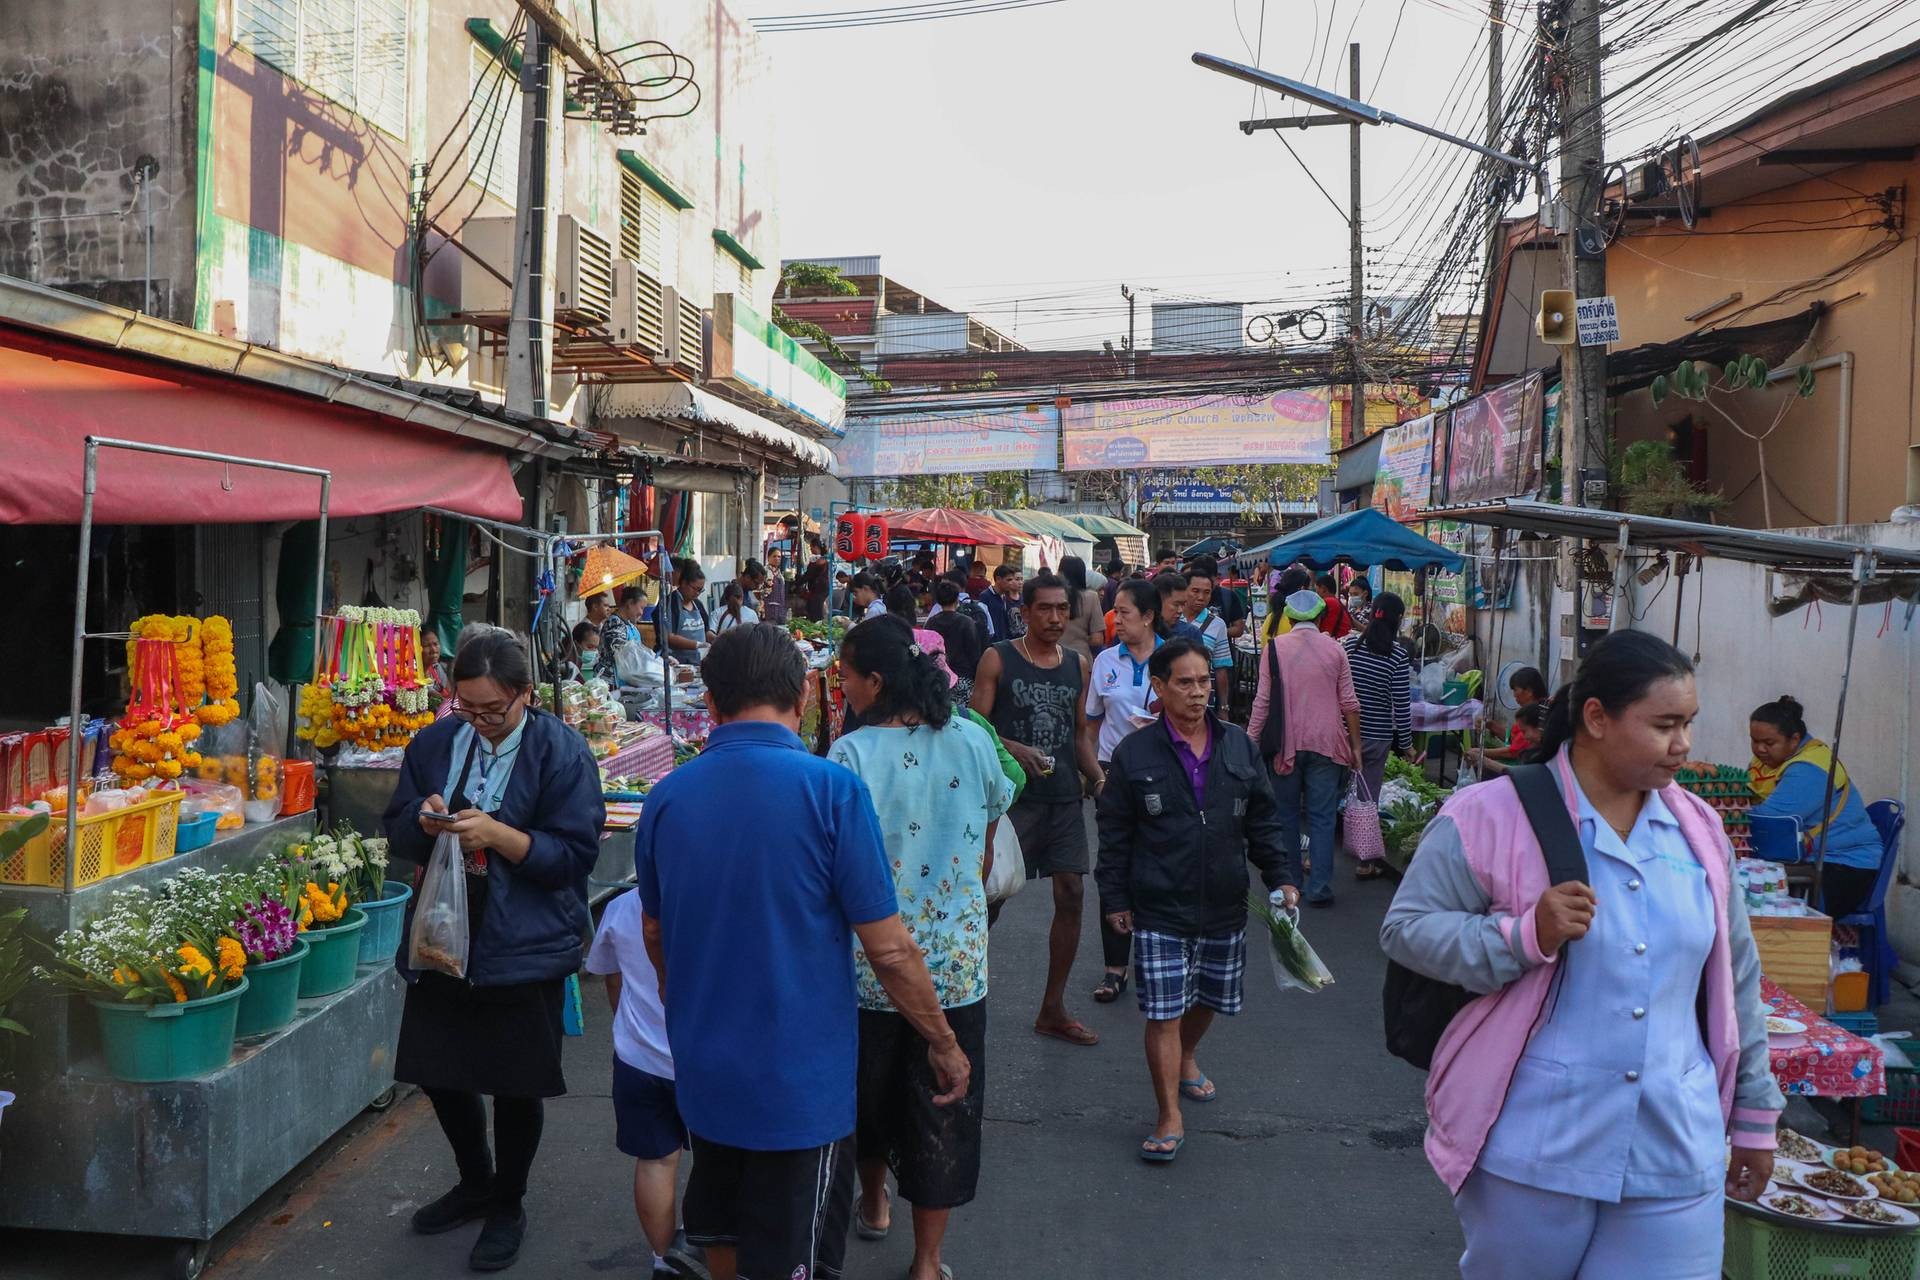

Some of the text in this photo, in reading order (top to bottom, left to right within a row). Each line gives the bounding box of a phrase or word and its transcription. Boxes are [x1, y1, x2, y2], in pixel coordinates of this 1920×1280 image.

[1577, 299, 1615, 319] รถรับจ้าง
[1600, 320, 1608, 329] 6
[1152, 515, 1231, 527] รงเรียนกวดวิชา
[838, 520, 854, 553] 寿司
[866, 524, 882, 553] 寿司
